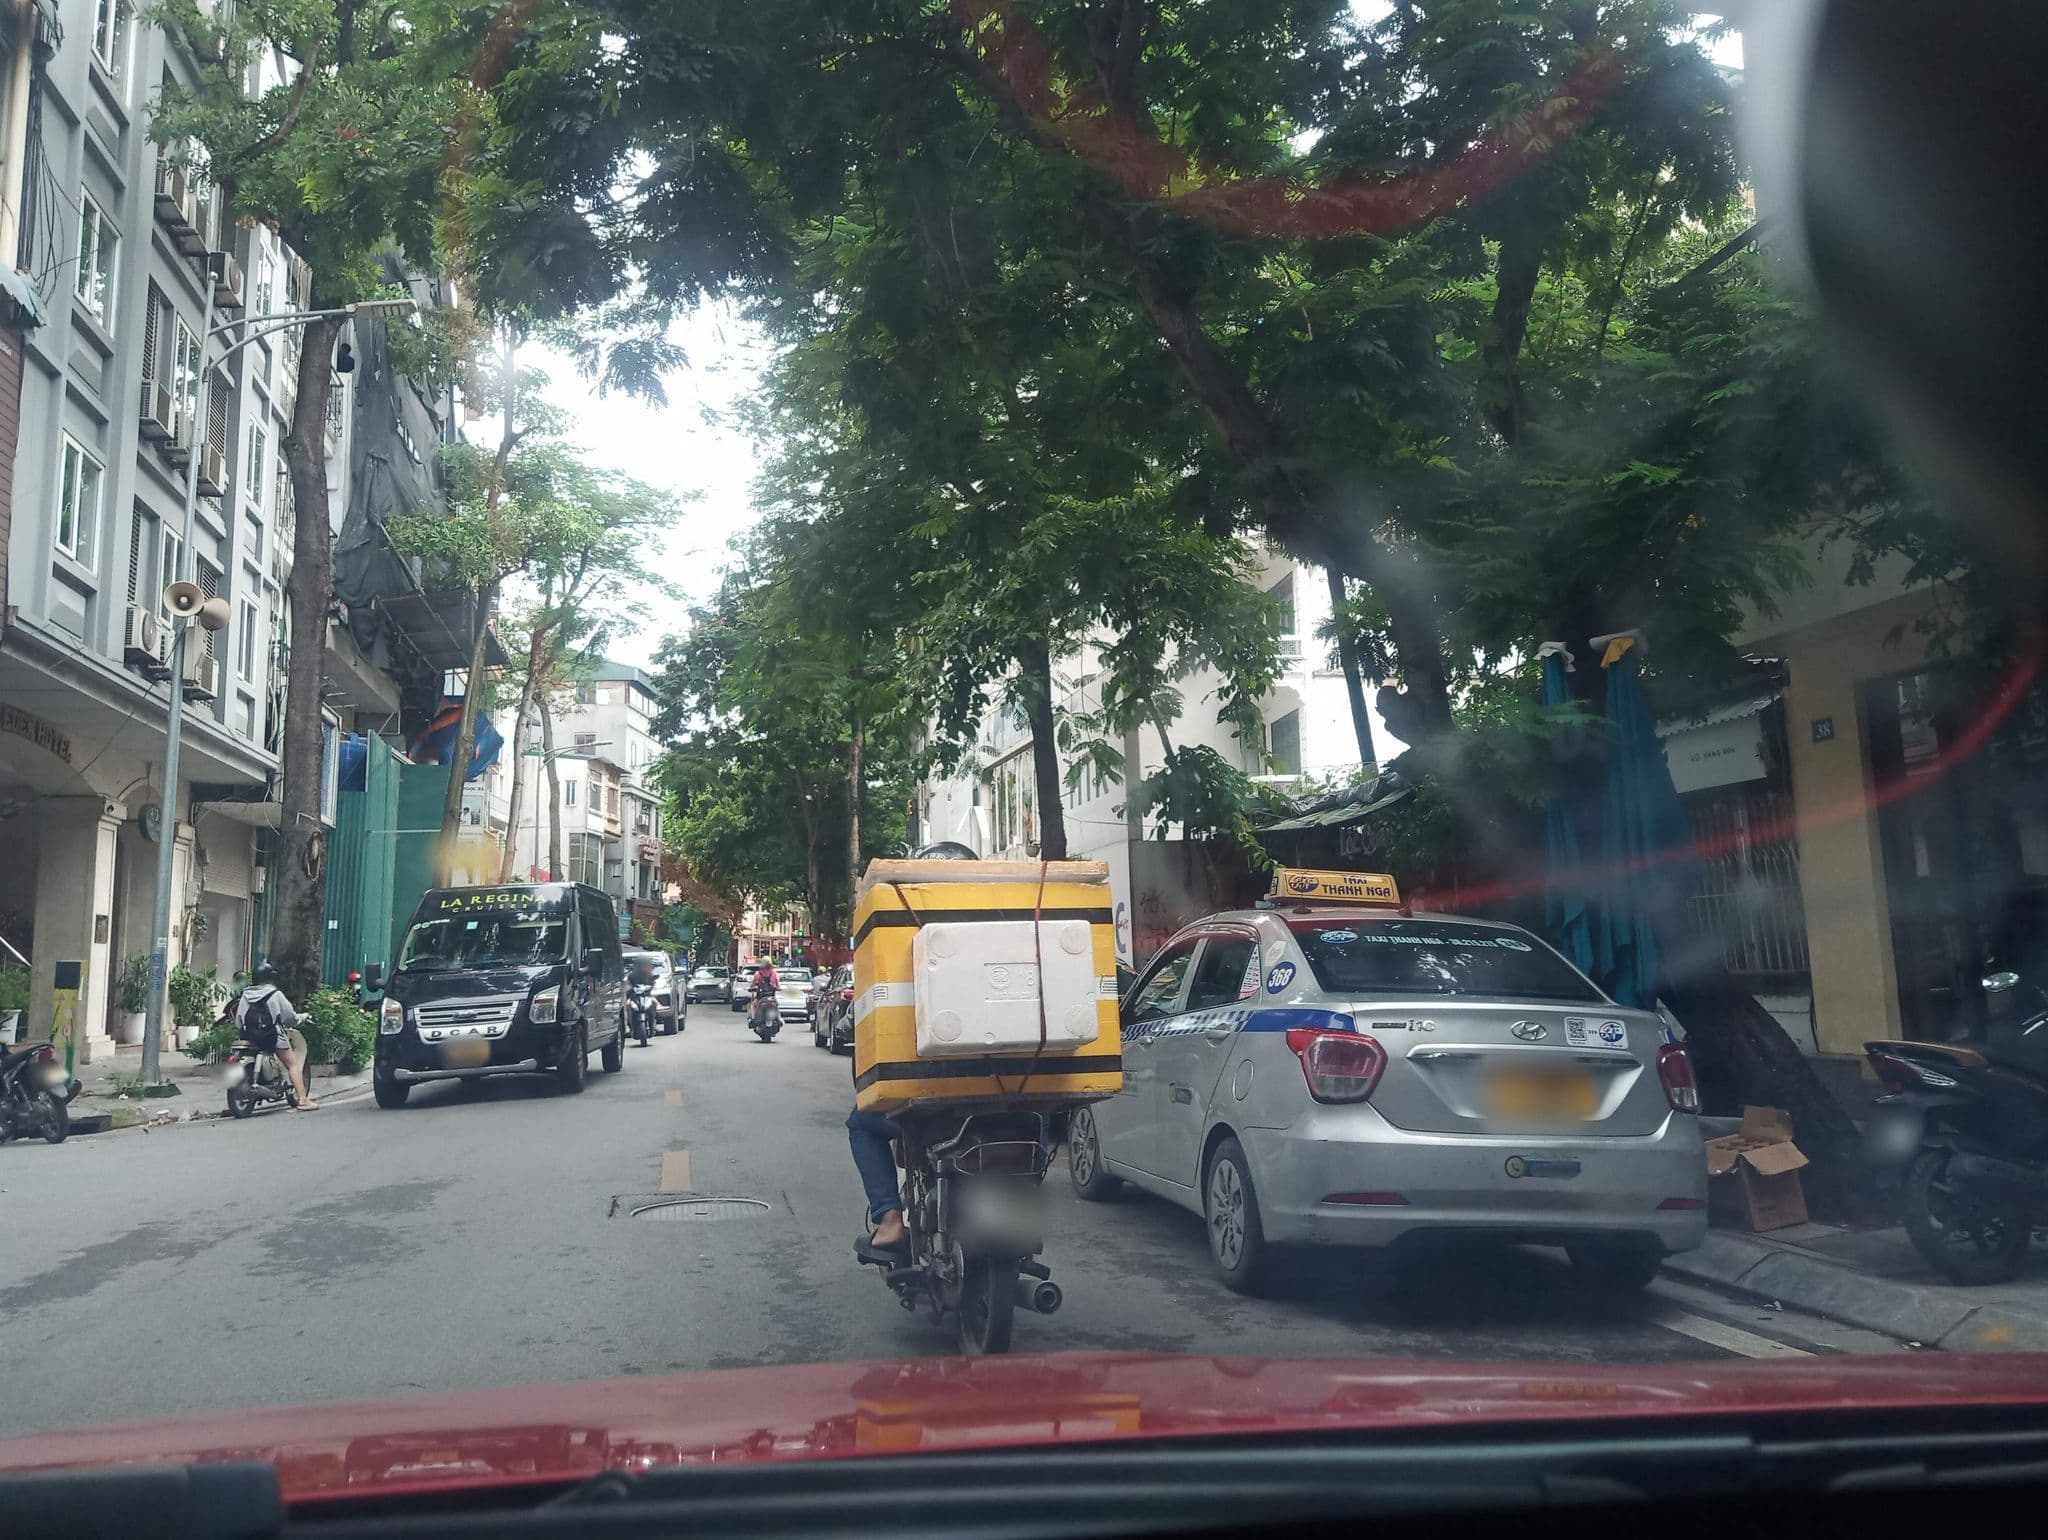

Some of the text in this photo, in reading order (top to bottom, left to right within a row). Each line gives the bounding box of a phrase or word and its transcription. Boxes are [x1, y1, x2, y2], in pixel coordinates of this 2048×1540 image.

[1815, 722, 1831, 739] 38
[1322, 883, 1363, 896] THANH
[1366, 886, 1391, 896] NGA
[440, 893, 546, 909] LA REGINA
[452, 903, 528, 913] CRUISES
[1364, 935, 1388, 943] TAXI
[1389, 936, 1421, 944] THANH
[1421, 937, 1444, 945] NGA
[1268, 968, 1293, 988] 368
[431, 1025, 498, 1038] DCAR
